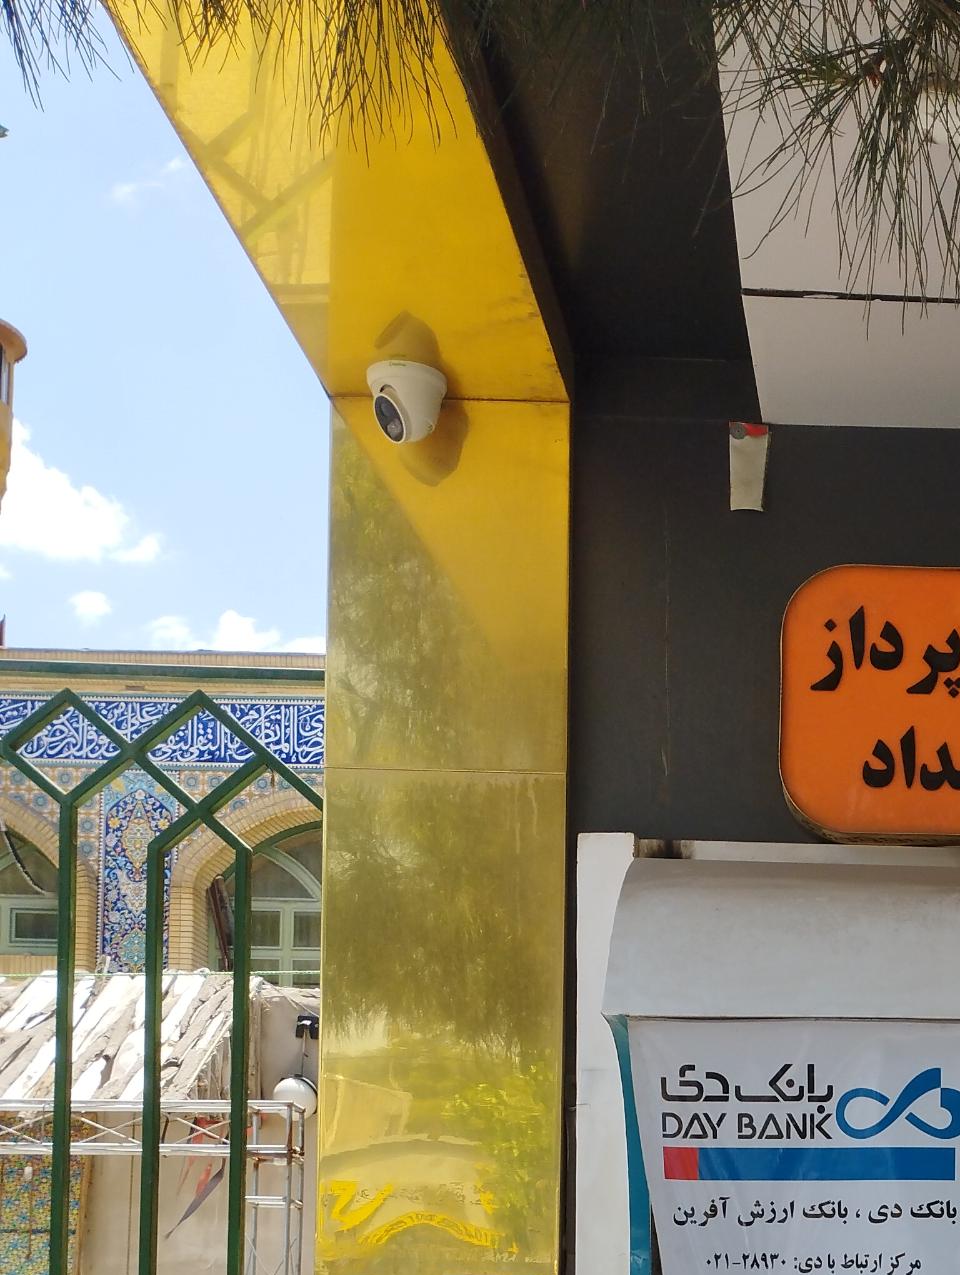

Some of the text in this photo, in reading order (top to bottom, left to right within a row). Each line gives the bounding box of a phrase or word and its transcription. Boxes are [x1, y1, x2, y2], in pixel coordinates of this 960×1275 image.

[661, 1064, 833, 1114] بانک دی
[661, 1112, 833, 1140] DAY BANK
[673, 1196, 730, 1227] آفرین
[737, 1200, 795, 1227] ارزش
[802, 1200, 848, 1224] بانک
[911, 1200, 957, 1224] بانک
[841, 1253, 883, 1274] ارتباط
[887, 1253, 922, 1275] مرکز
